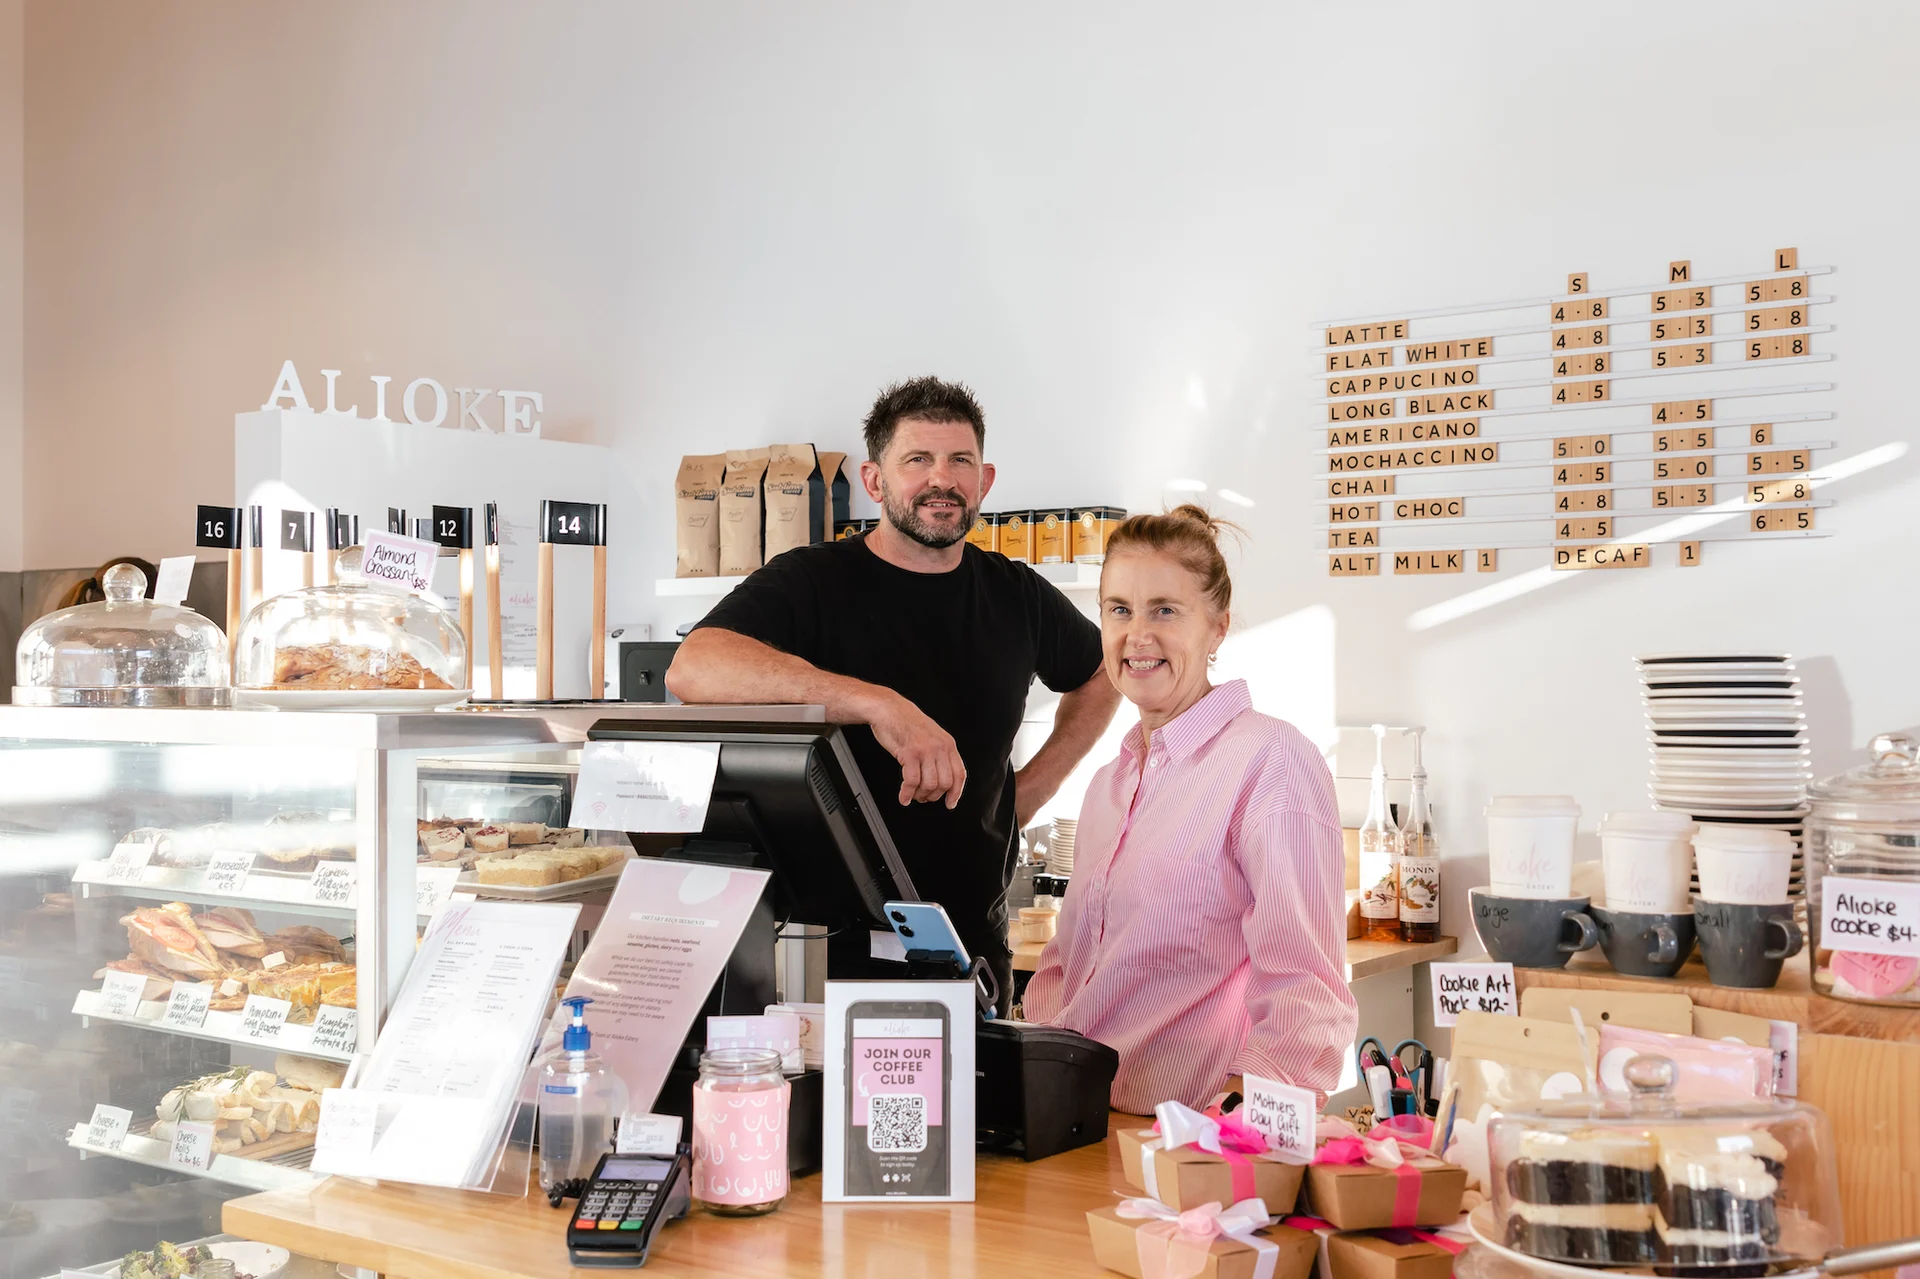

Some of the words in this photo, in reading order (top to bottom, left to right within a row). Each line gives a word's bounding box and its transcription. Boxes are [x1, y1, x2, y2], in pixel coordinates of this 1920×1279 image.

[1572, 278, 1582, 292] S
[1671, 266, 1688, 281] M
[1779, 254, 1790, 269] L
[1328, 324, 1404, 345] LATTE
[1330, 351, 1389, 370] FLAT
[1406, 341, 1488, 363] WHITE
[1329, 370, 1475, 395] CAPPUCINO
[260, 359, 543, 440] ALIOKE
[1331, 402, 1391, 420] LONG
[1410, 394, 1488, 414] BLACK
[1330, 422, 1476, 446] AMERICANO
[1330, 448, 1494, 471] MOCHACCINO
[1754, 429, 1765, 443] 6
[1331, 480, 1387, 495] CHAI
[1332, 506, 1375, 520] HOT
[1397, 502, 1459, 518] CHOC
[204, 520, 224, 538] 16
[288, 522, 298, 540] 7
[439, 520, 458, 537] 12
[558, 515, 581, 534] 14
[1332, 532, 1374, 546] TEA
[373, 544, 416, 566] Almond
[1332, 558, 1374, 571] ALT
[1396, 554, 1458, 569] MILK
[1482, 553, 1491, 567] 1
[1558, 547, 1644, 565] DECAF
[1685, 546, 1694, 560] 1
[366, 558, 418, 585] Croissant
[1402, 866, 1435, 874] MONIN
[1836, 893, 1898, 916] Alioke
[1439, 974, 1480, 992] Cookie
[1486, 974, 1511, 994] Art
[1439, 995, 1470, 1014] Pack
[319, 1014, 349, 1030] Pumpkin
[864, 1048, 899, 1059] JOIN
[903, 1048, 931, 1059] OUR
[872, 1062, 923, 1072] COFFEE
[880, 1074, 915, 1085] CLUB
[1252, 1092, 1296, 1117] Mothers
[1250, 1108, 1272, 1132] Day
[1276, 1114, 1300, 1135] Gift
[177, 1130, 198, 1144] Cheese
